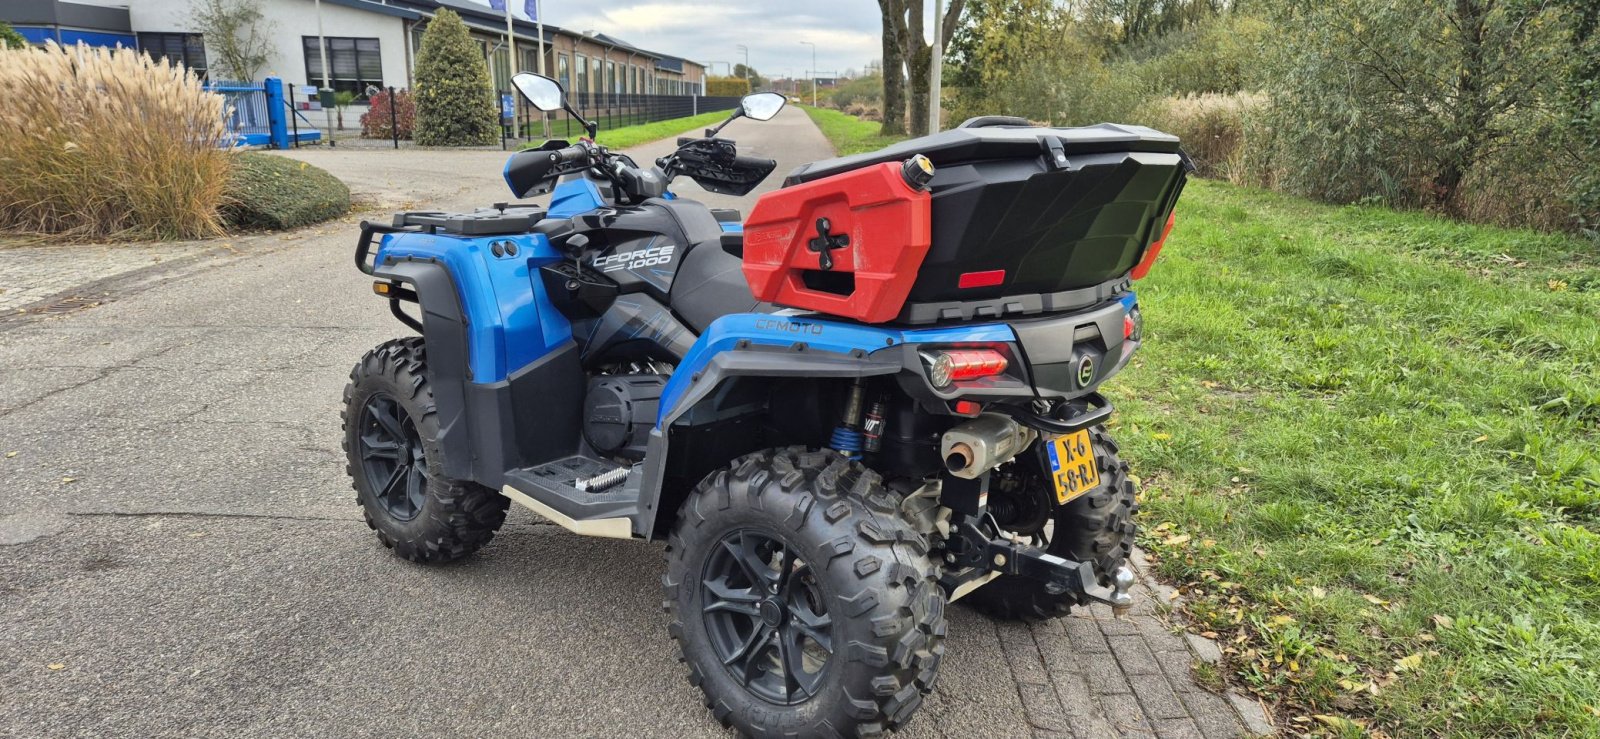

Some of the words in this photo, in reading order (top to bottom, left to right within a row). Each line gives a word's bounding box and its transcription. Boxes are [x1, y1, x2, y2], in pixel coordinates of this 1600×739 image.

[593, 245, 675, 267] CFORCE
[628, 255, 672, 270] 1000
[755, 319, 824, 335] CFMOTO
[1062, 434, 1086, 463] X-6
[1057, 460, 1096, 497] 58-RJ
